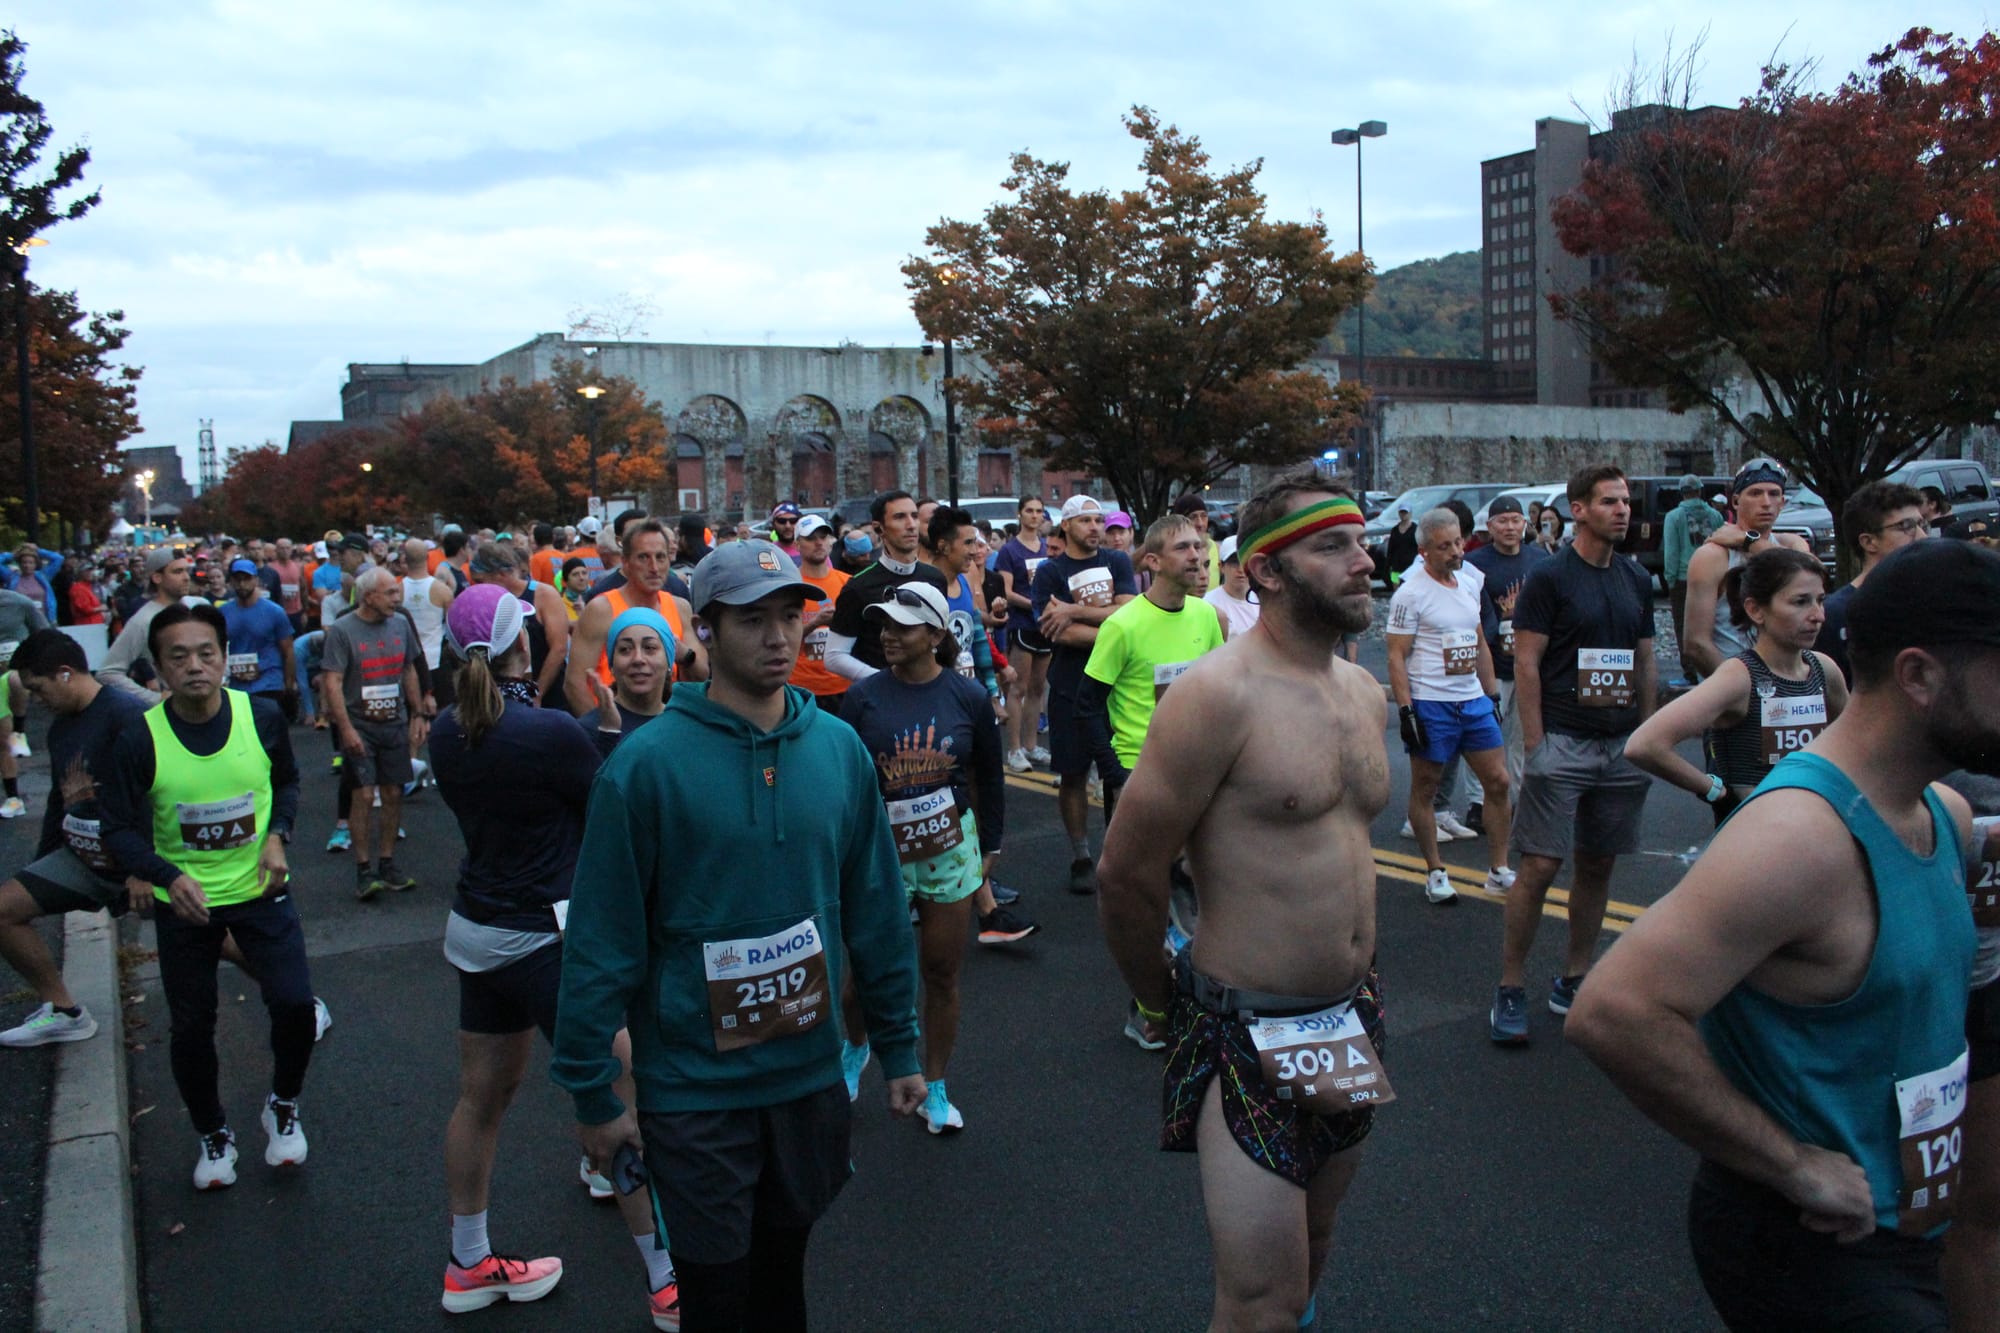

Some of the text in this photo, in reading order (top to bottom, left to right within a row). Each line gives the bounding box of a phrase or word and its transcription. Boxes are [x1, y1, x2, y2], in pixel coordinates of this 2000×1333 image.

[1079, 581, 1109, 598] 2563
[1600, 653, 1631, 664] CHRIS
[1590, 671, 1627, 687] 80 A
[367, 699, 397, 709] 2006
[1774, 728, 1814, 750] 150
[911, 794, 946, 815] ROSA
[196, 822, 245, 840] 49 A
[902, 813, 950, 840] 2486
[747, 929, 814, 965] RAMOS
[736, 967, 806, 1008] 2519
[796, 1011, 817, 1026] 2519
[1274, 1047, 1335, 1080] 309
[1347, 1043, 1369, 1069] A
[1350, 1089, 1379, 1103] 309 A
[1917, 1125, 1962, 1178] 120
